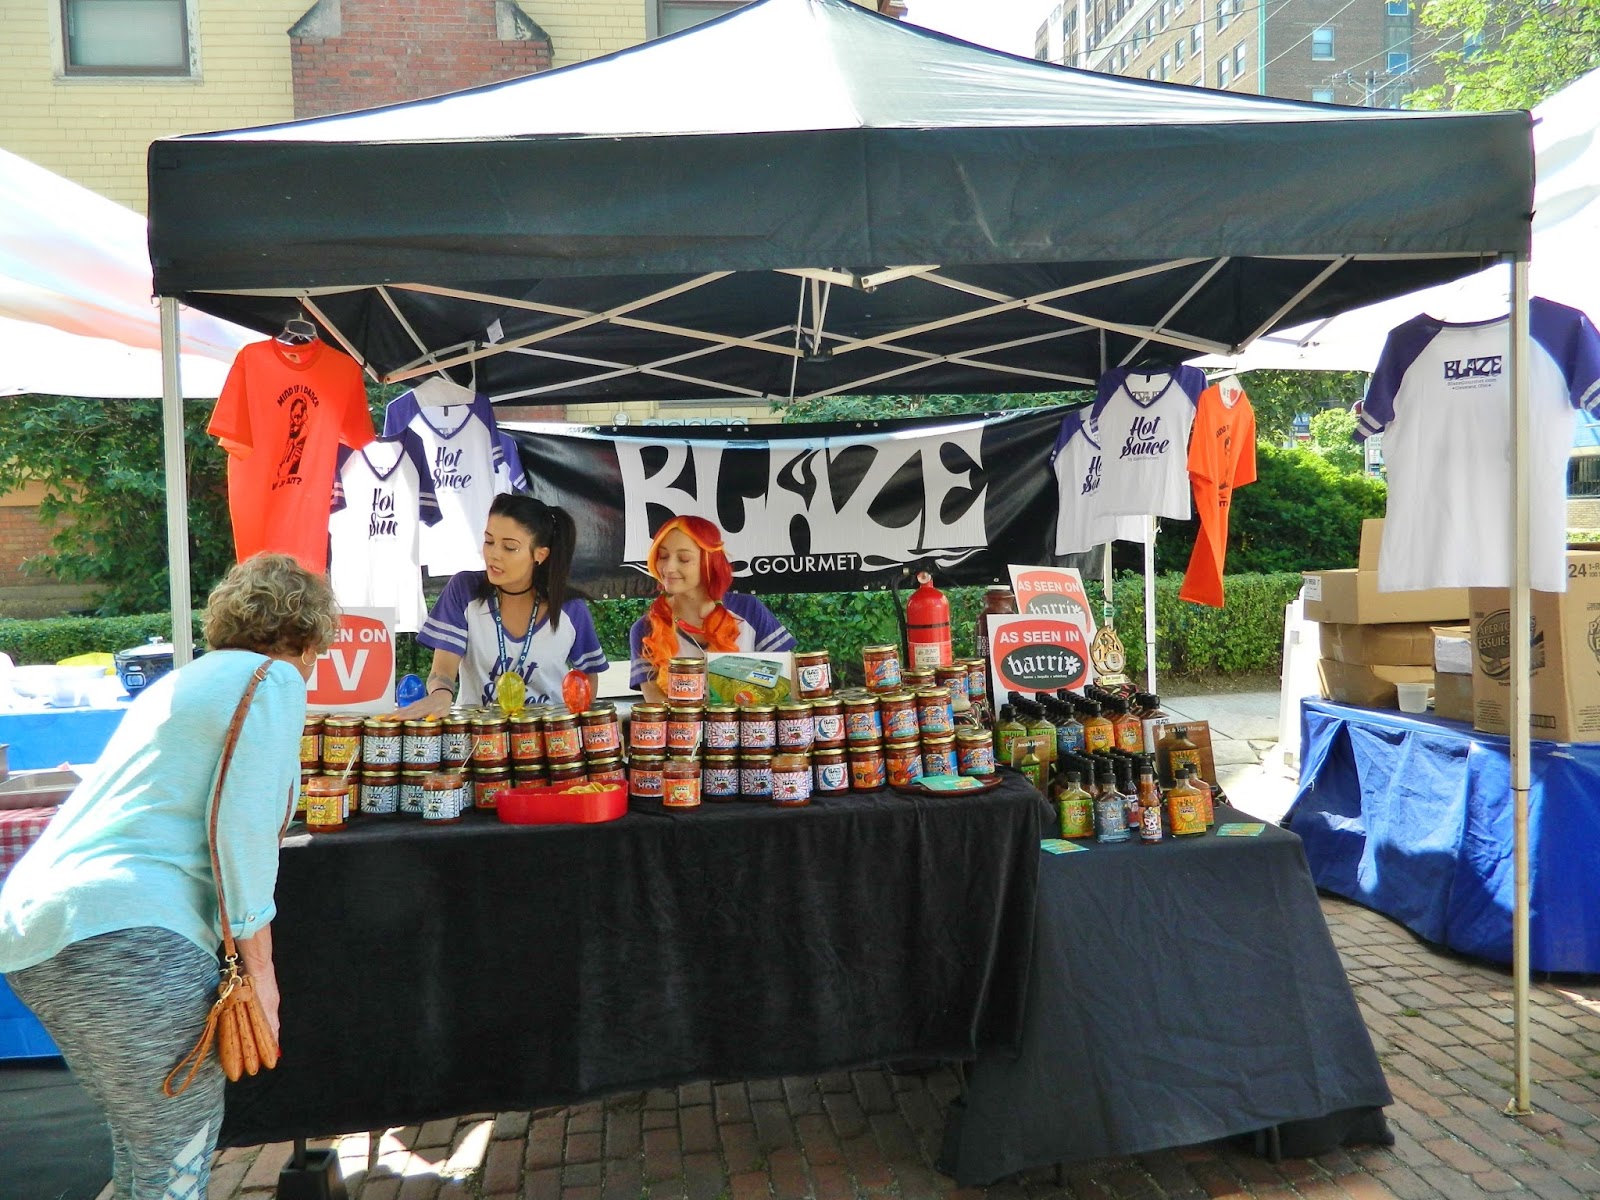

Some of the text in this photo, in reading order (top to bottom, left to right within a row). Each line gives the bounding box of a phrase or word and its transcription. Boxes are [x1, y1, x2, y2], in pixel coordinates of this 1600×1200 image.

[1444, 355, 1502, 379] BLAZE
[1130, 416, 1160, 440] Hot
[435, 446, 463, 472] Hot
[1119, 437, 1169, 459] Sauce
[613, 424, 989, 563] BLAZE
[754, 554, 858, 576] GOURMET
[1568, 563, 1587, 578] 24
[1018, 581, 1080, 592] AS SEEN ON
[360, 628, 387, 643] ON
[999, 630, 1080, 644] AS SEEN IN
